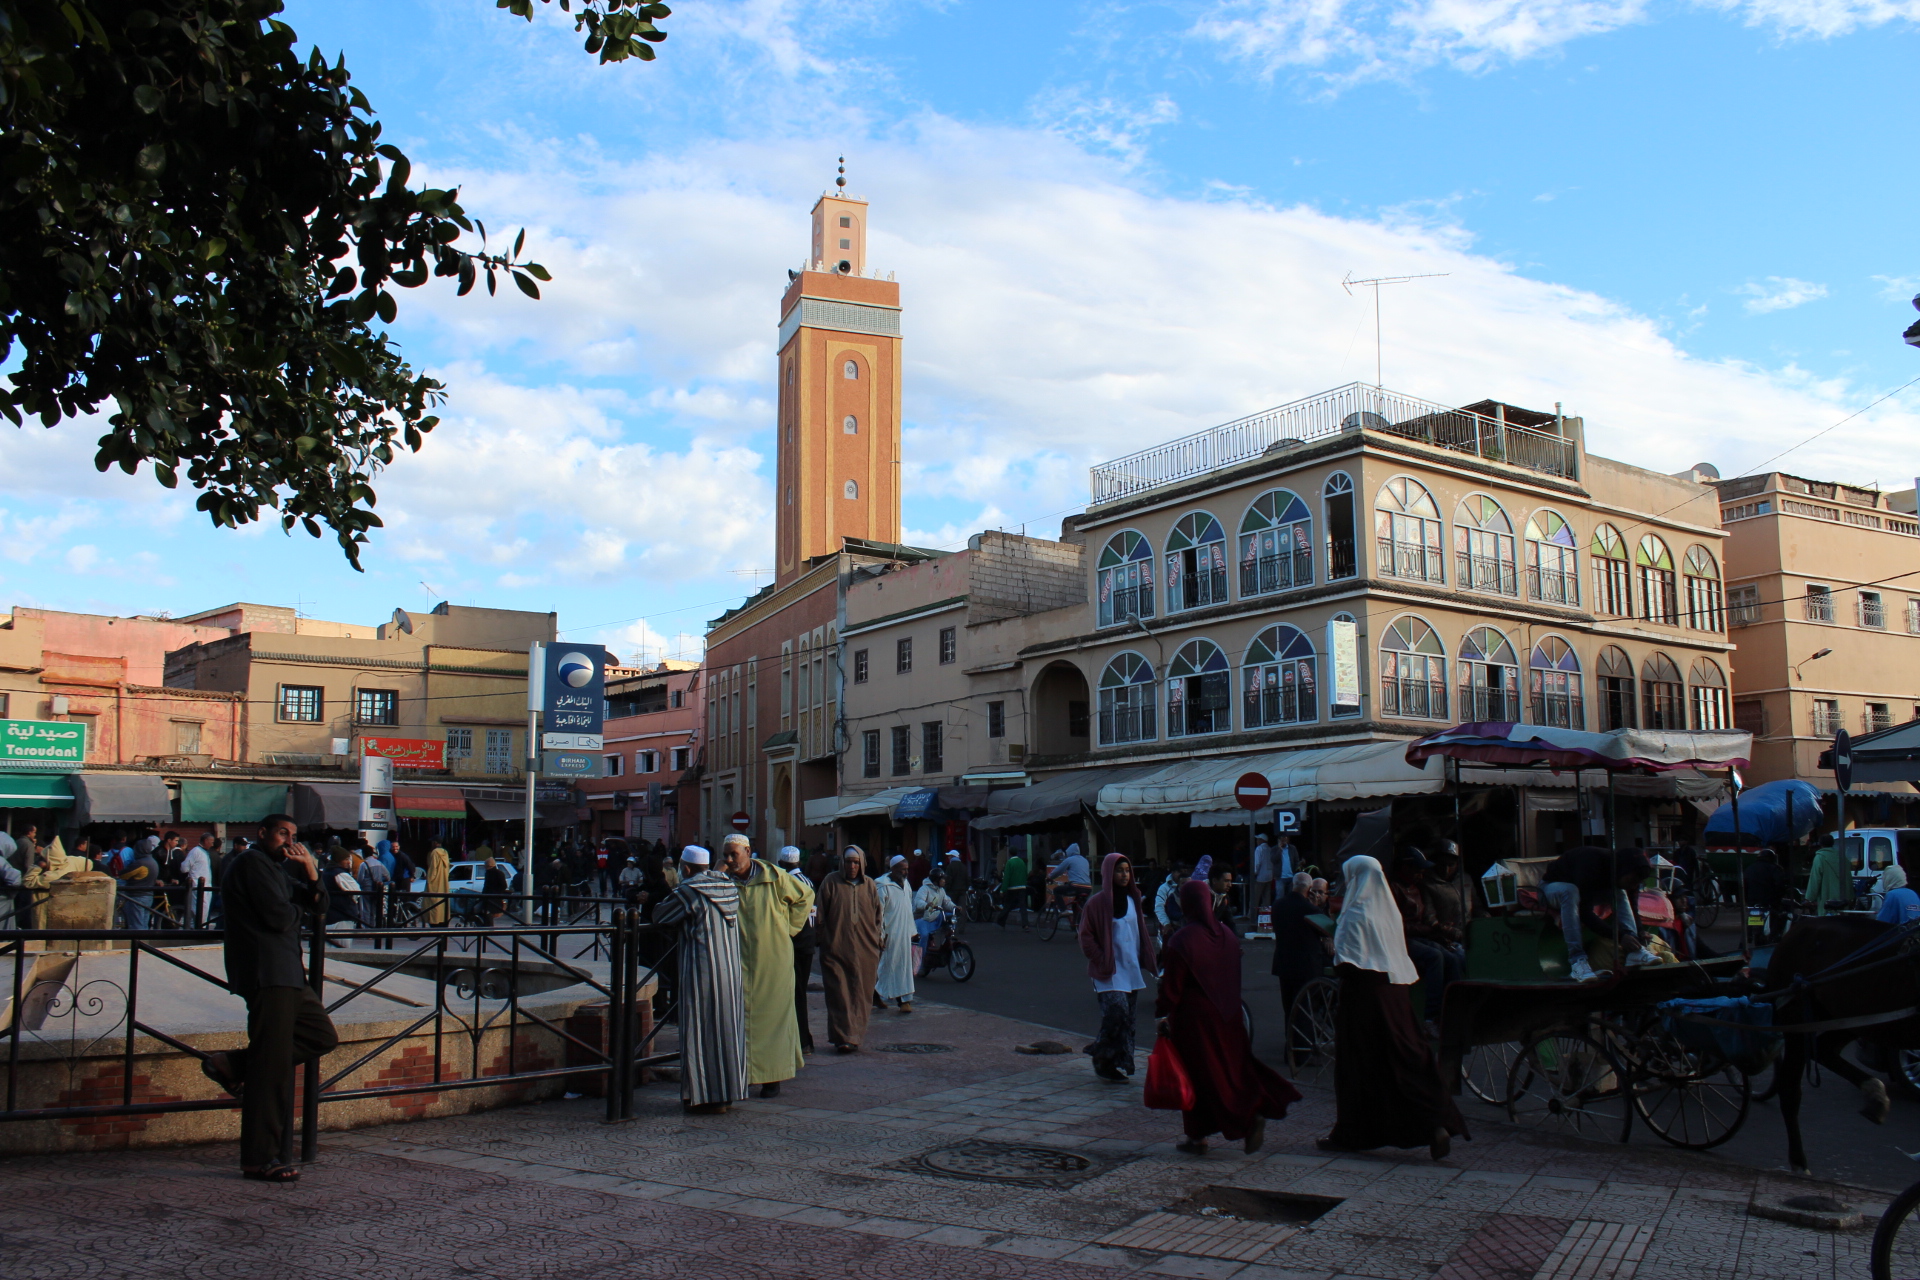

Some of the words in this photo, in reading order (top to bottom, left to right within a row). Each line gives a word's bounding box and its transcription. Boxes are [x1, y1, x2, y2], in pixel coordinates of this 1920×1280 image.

[556, 694, 576, 708] المغربي
[575, 696, 593, 710] البنك
[7, 723, 79, 741] صيدلية
[6, 744, 78, 757] Taroudant
[1279, 811, 1296, 832] P
